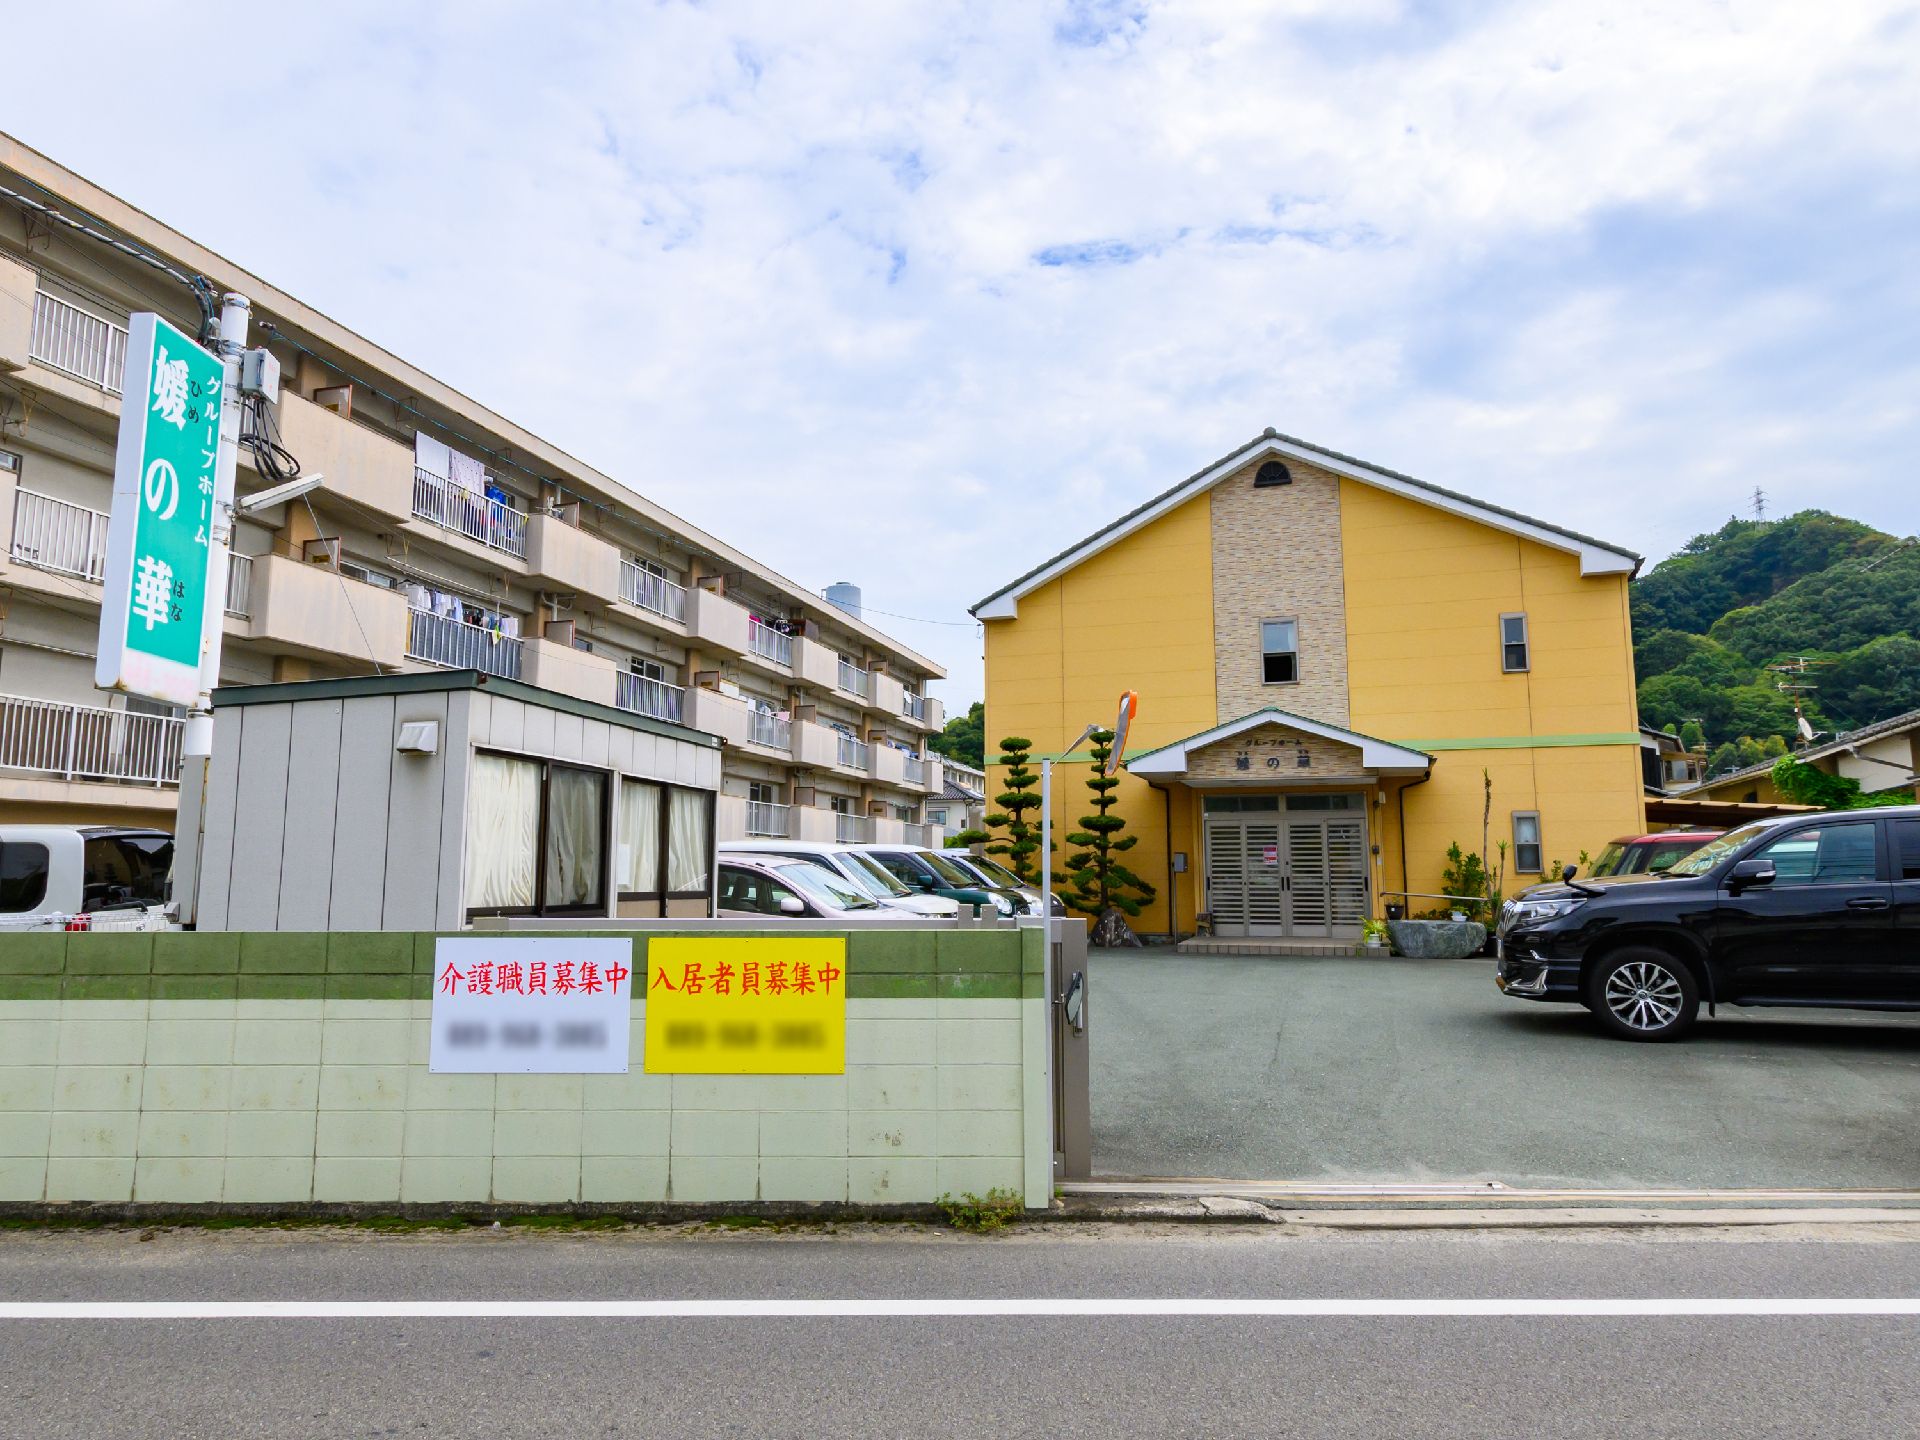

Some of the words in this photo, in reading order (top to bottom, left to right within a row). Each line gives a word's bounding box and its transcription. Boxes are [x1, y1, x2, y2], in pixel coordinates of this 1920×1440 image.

[188, 380, 203, 424] ひめ
[132, 344, 189, 631] 媛の華
[171, 579, 185, 622] はな
[438, 961, 629, 995] 介護職員募集中
[651, 961, 841, 995] 入居者員募集中
